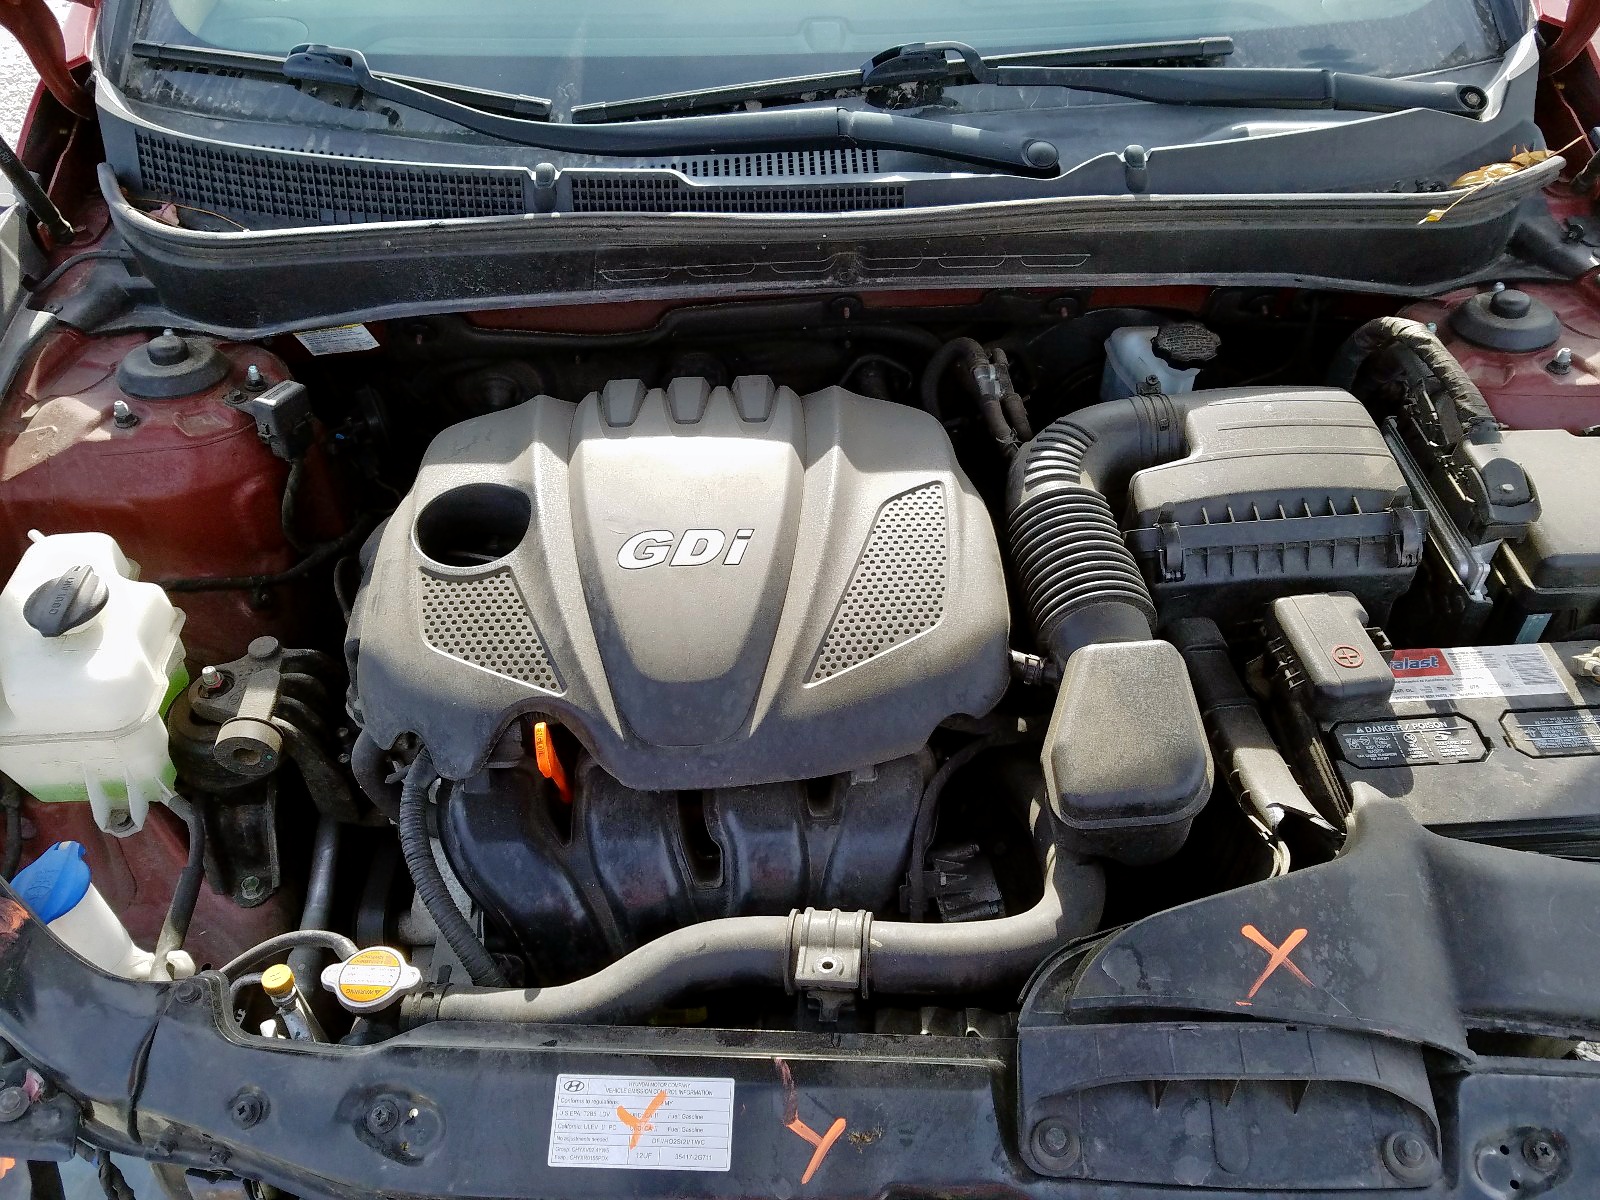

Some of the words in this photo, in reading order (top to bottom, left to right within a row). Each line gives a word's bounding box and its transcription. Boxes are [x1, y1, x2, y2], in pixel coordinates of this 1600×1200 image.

[617, 528, 755, 570] GDi
[1364, 724, 1403, 733] DANGER
[1411, 721, 1448, 730] POISON
